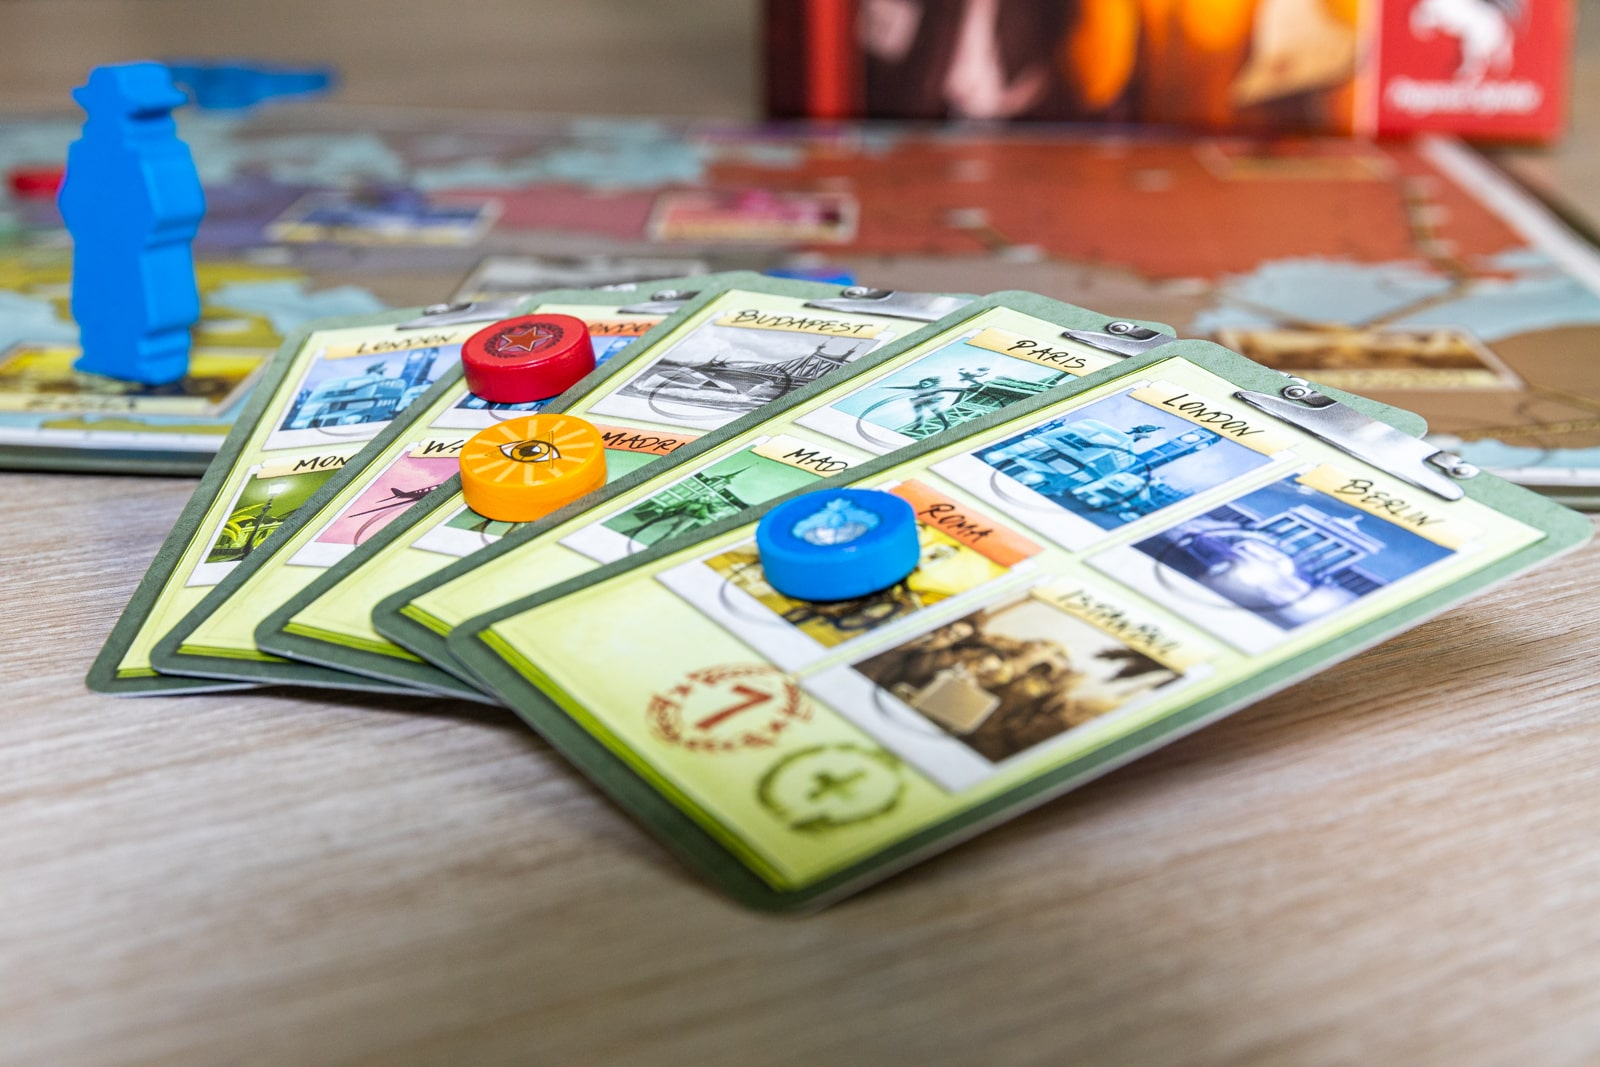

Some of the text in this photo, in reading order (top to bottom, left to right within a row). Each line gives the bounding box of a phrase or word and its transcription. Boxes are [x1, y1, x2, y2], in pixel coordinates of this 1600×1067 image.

[735, 310, 873, 335] BUDAPEST
[356, 332, 457, 353] LONDON
[1007, 339, 1087, 370] PARIS
[1162, 393, 1264, 437] LONDON
[1335, 478, 1445, 527] BERLIN
[917, 503, 994, 544] ROMA
